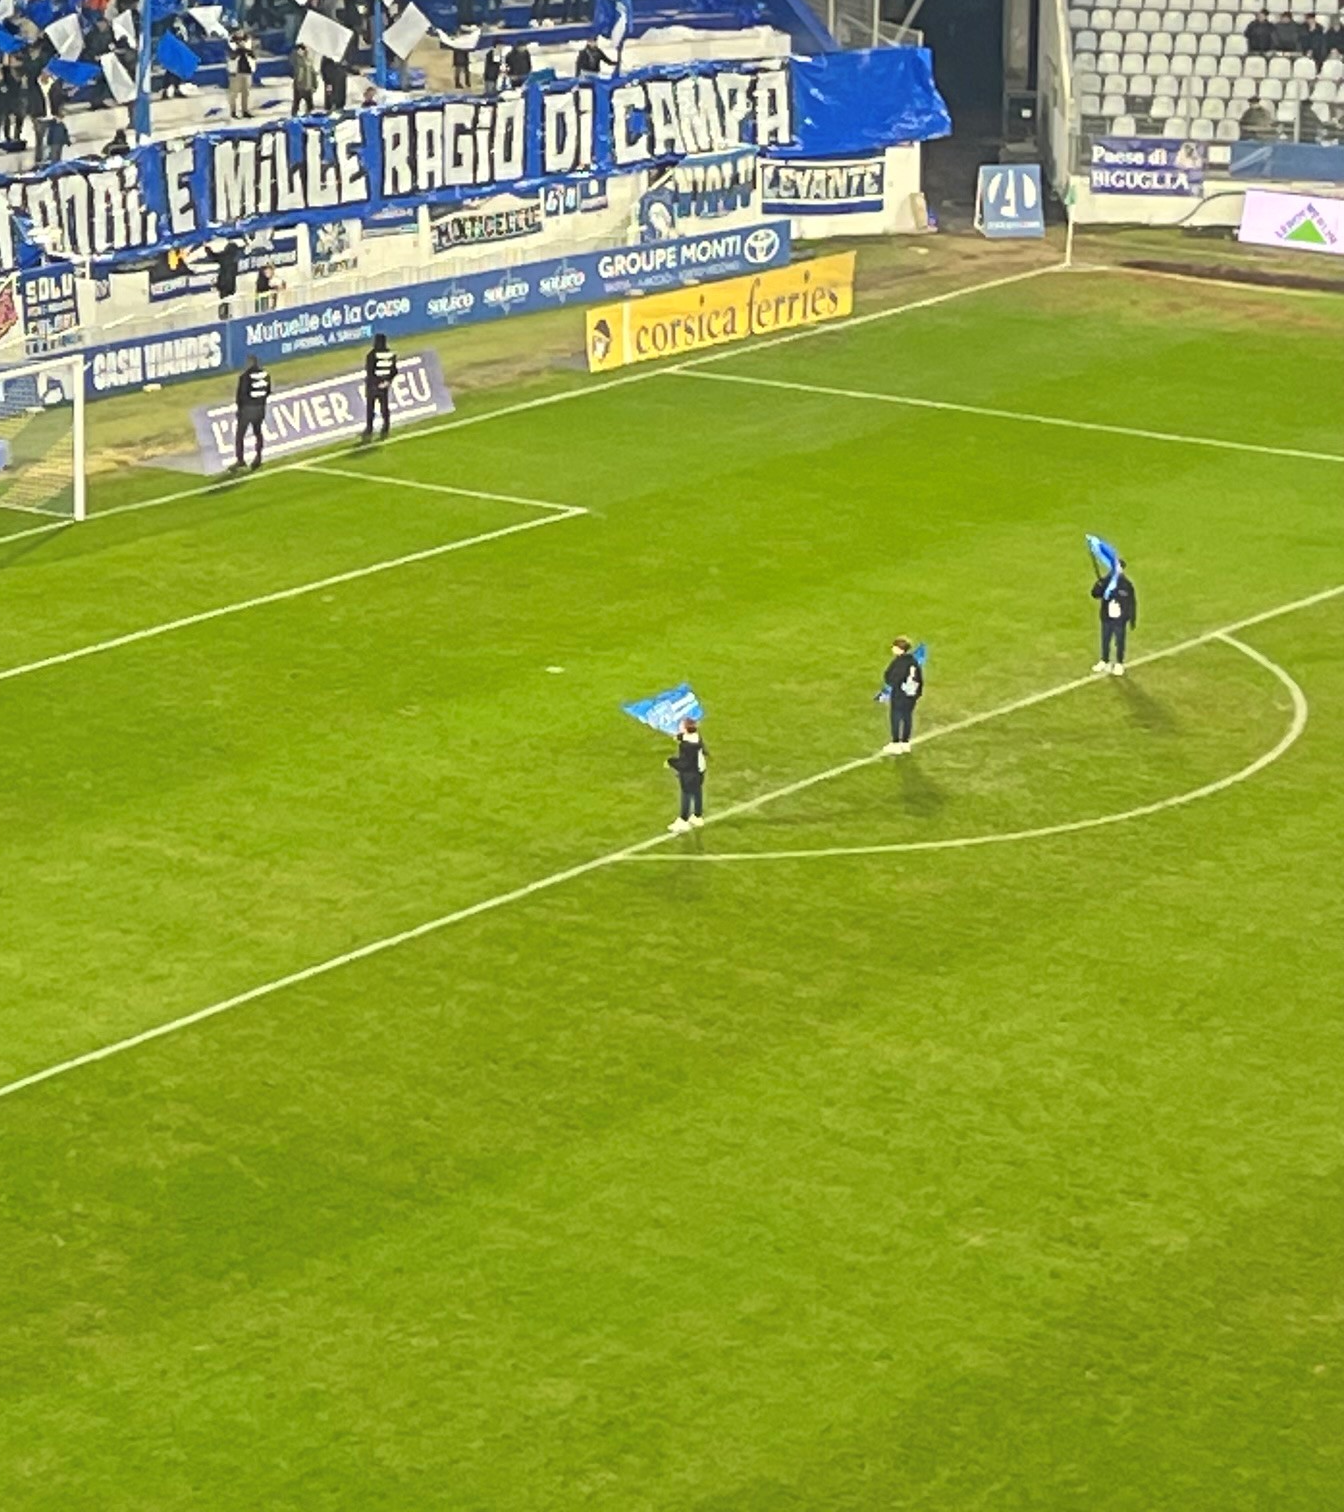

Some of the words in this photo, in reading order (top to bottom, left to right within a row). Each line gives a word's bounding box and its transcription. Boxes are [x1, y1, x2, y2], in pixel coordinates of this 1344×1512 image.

[763, 164, 882, 199] LEVANTE
[1091, 169, 1190, 190] BIGUGLIA
[598, 246, 678, 278] GROUPE
[680, 235, 742, 265] MONTI
[246, 311, 320, 346] Mutuelle
[322, 307, 342, 328] de
[344, 304, 362, 325] la
[364, 297, 410, 321] Corse
[635, 295, 737, 355] corsica
[746, 270, 839, 336] ferries
[93, 346, 143, 390] CASH
[144, 331, 223, 379] VIANDES
